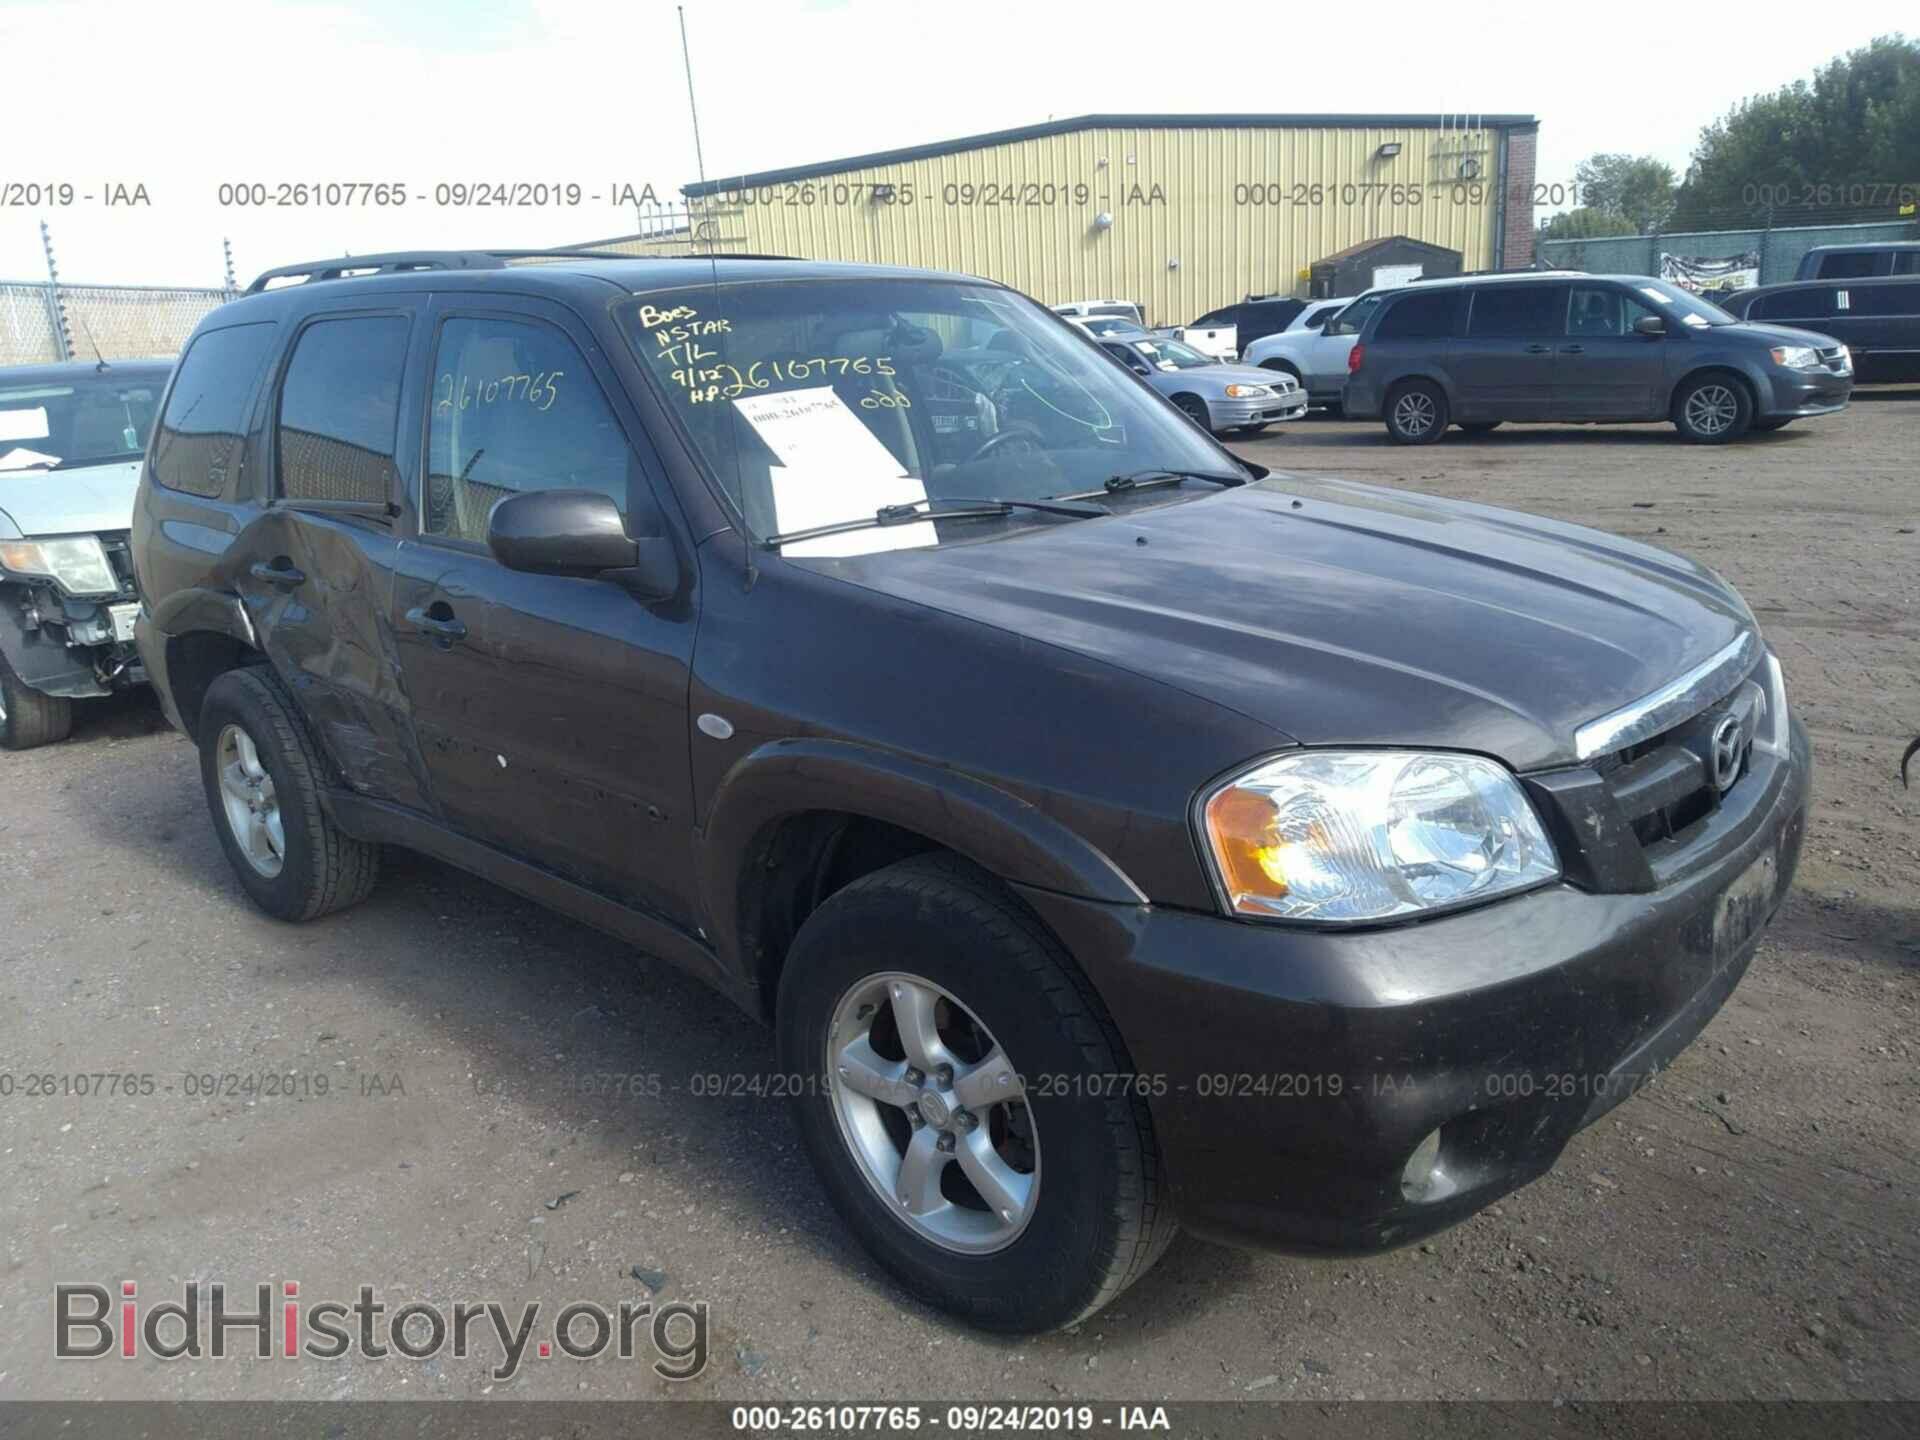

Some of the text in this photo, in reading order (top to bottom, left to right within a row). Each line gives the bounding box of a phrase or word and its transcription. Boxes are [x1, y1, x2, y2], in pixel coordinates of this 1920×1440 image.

[655, 319, 733, 347] NSTAR
[439, 371, 564, 410] 26107765
[717, 357, 896, 397] 26107765
